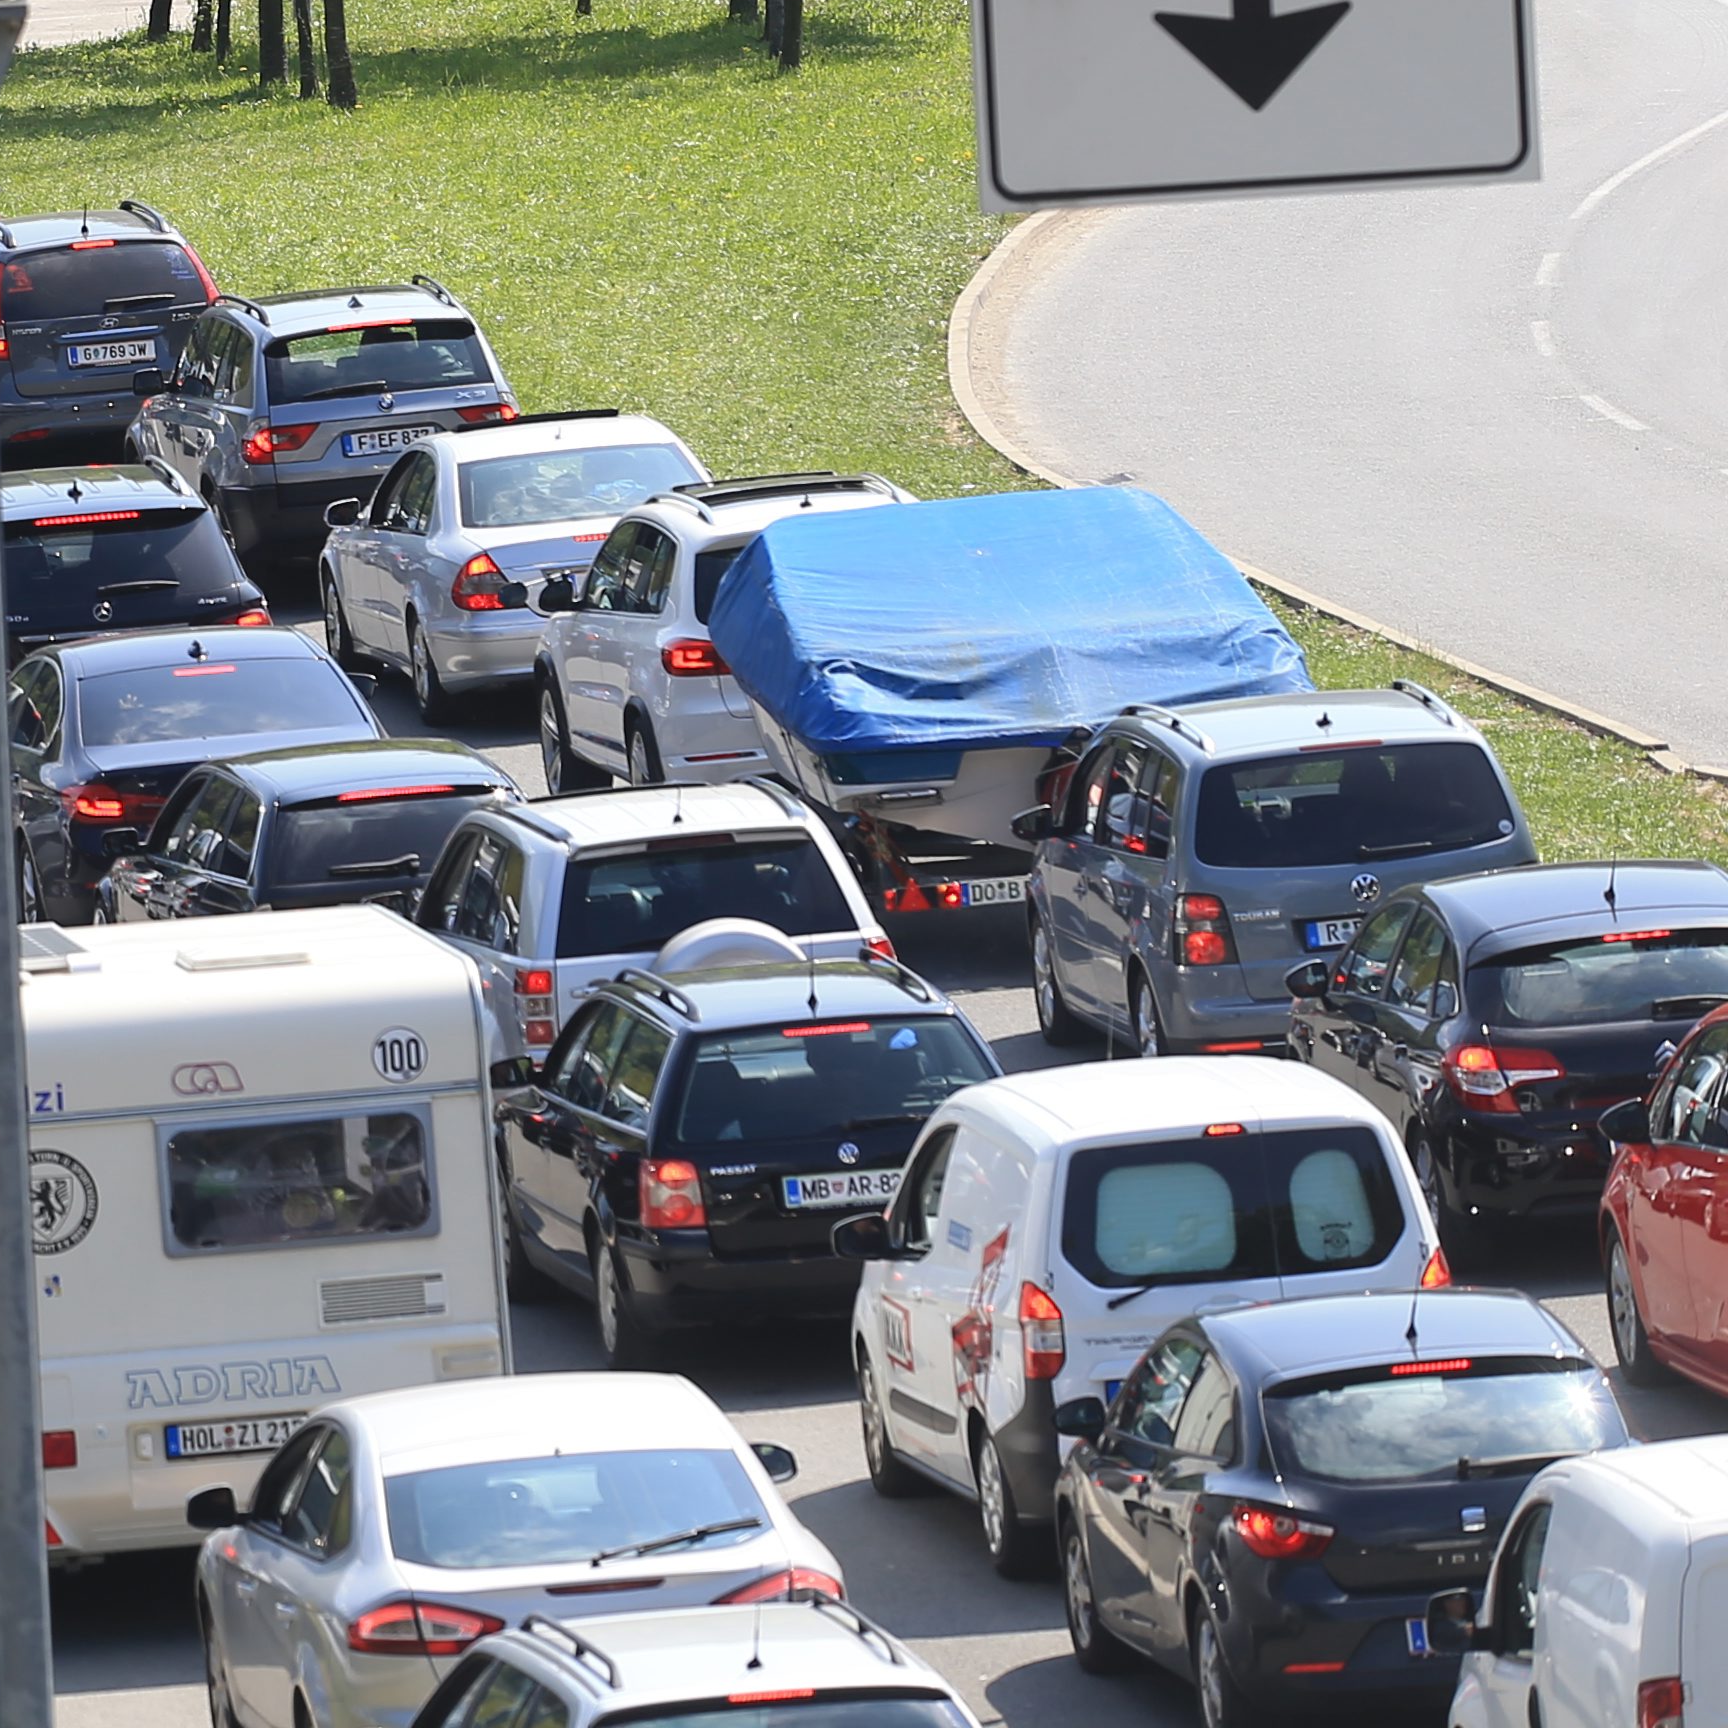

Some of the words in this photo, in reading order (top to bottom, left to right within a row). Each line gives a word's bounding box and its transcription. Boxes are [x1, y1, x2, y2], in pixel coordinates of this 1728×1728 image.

[102, 345, 126, 359] 769
[377, 1037, 422, 1074] 100
[709, 1163, 758, 1176] PASSAT
[125, 1354, 342, 1410] ADRIA
